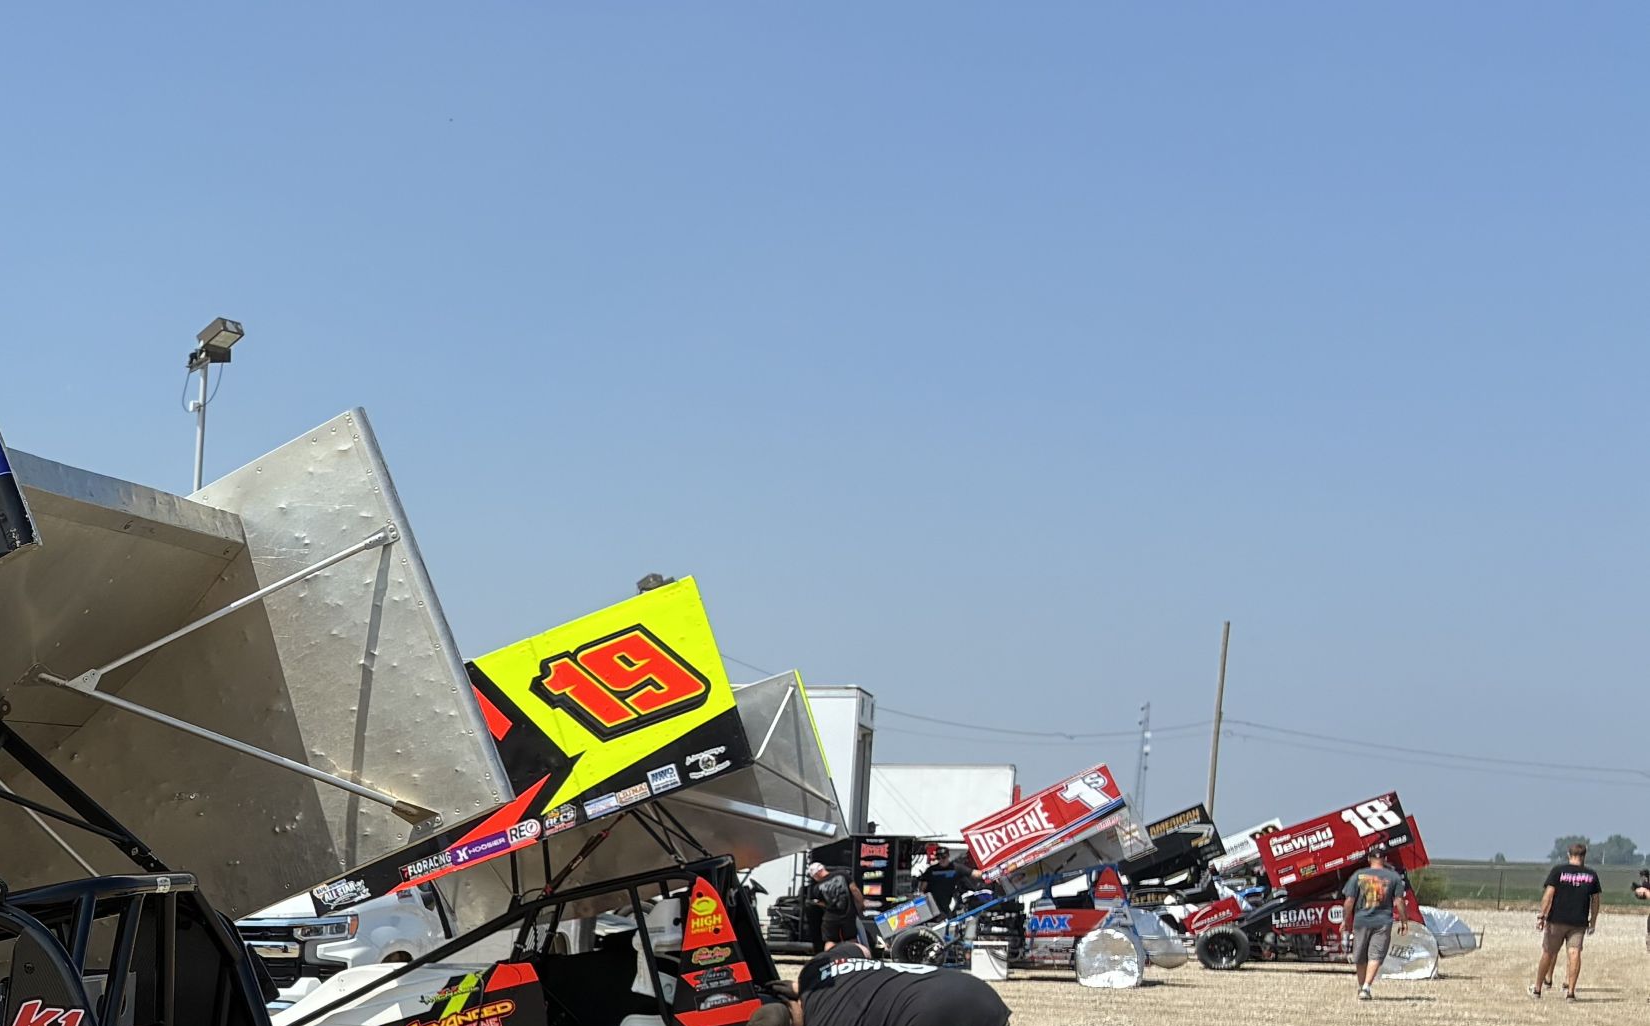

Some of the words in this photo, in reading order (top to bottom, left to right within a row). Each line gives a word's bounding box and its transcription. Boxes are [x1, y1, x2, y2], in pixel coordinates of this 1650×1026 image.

[540, 629, 708, 728] 19
[969, 800, 1054, 861] DRYDENE
[1270, 827, 1334, 858] DeWald
[468, 836, 506, 854] HOOSIER
[691, 914, 722, 929] HIGH
[1272, 907, 1325, 926] LEGACY
